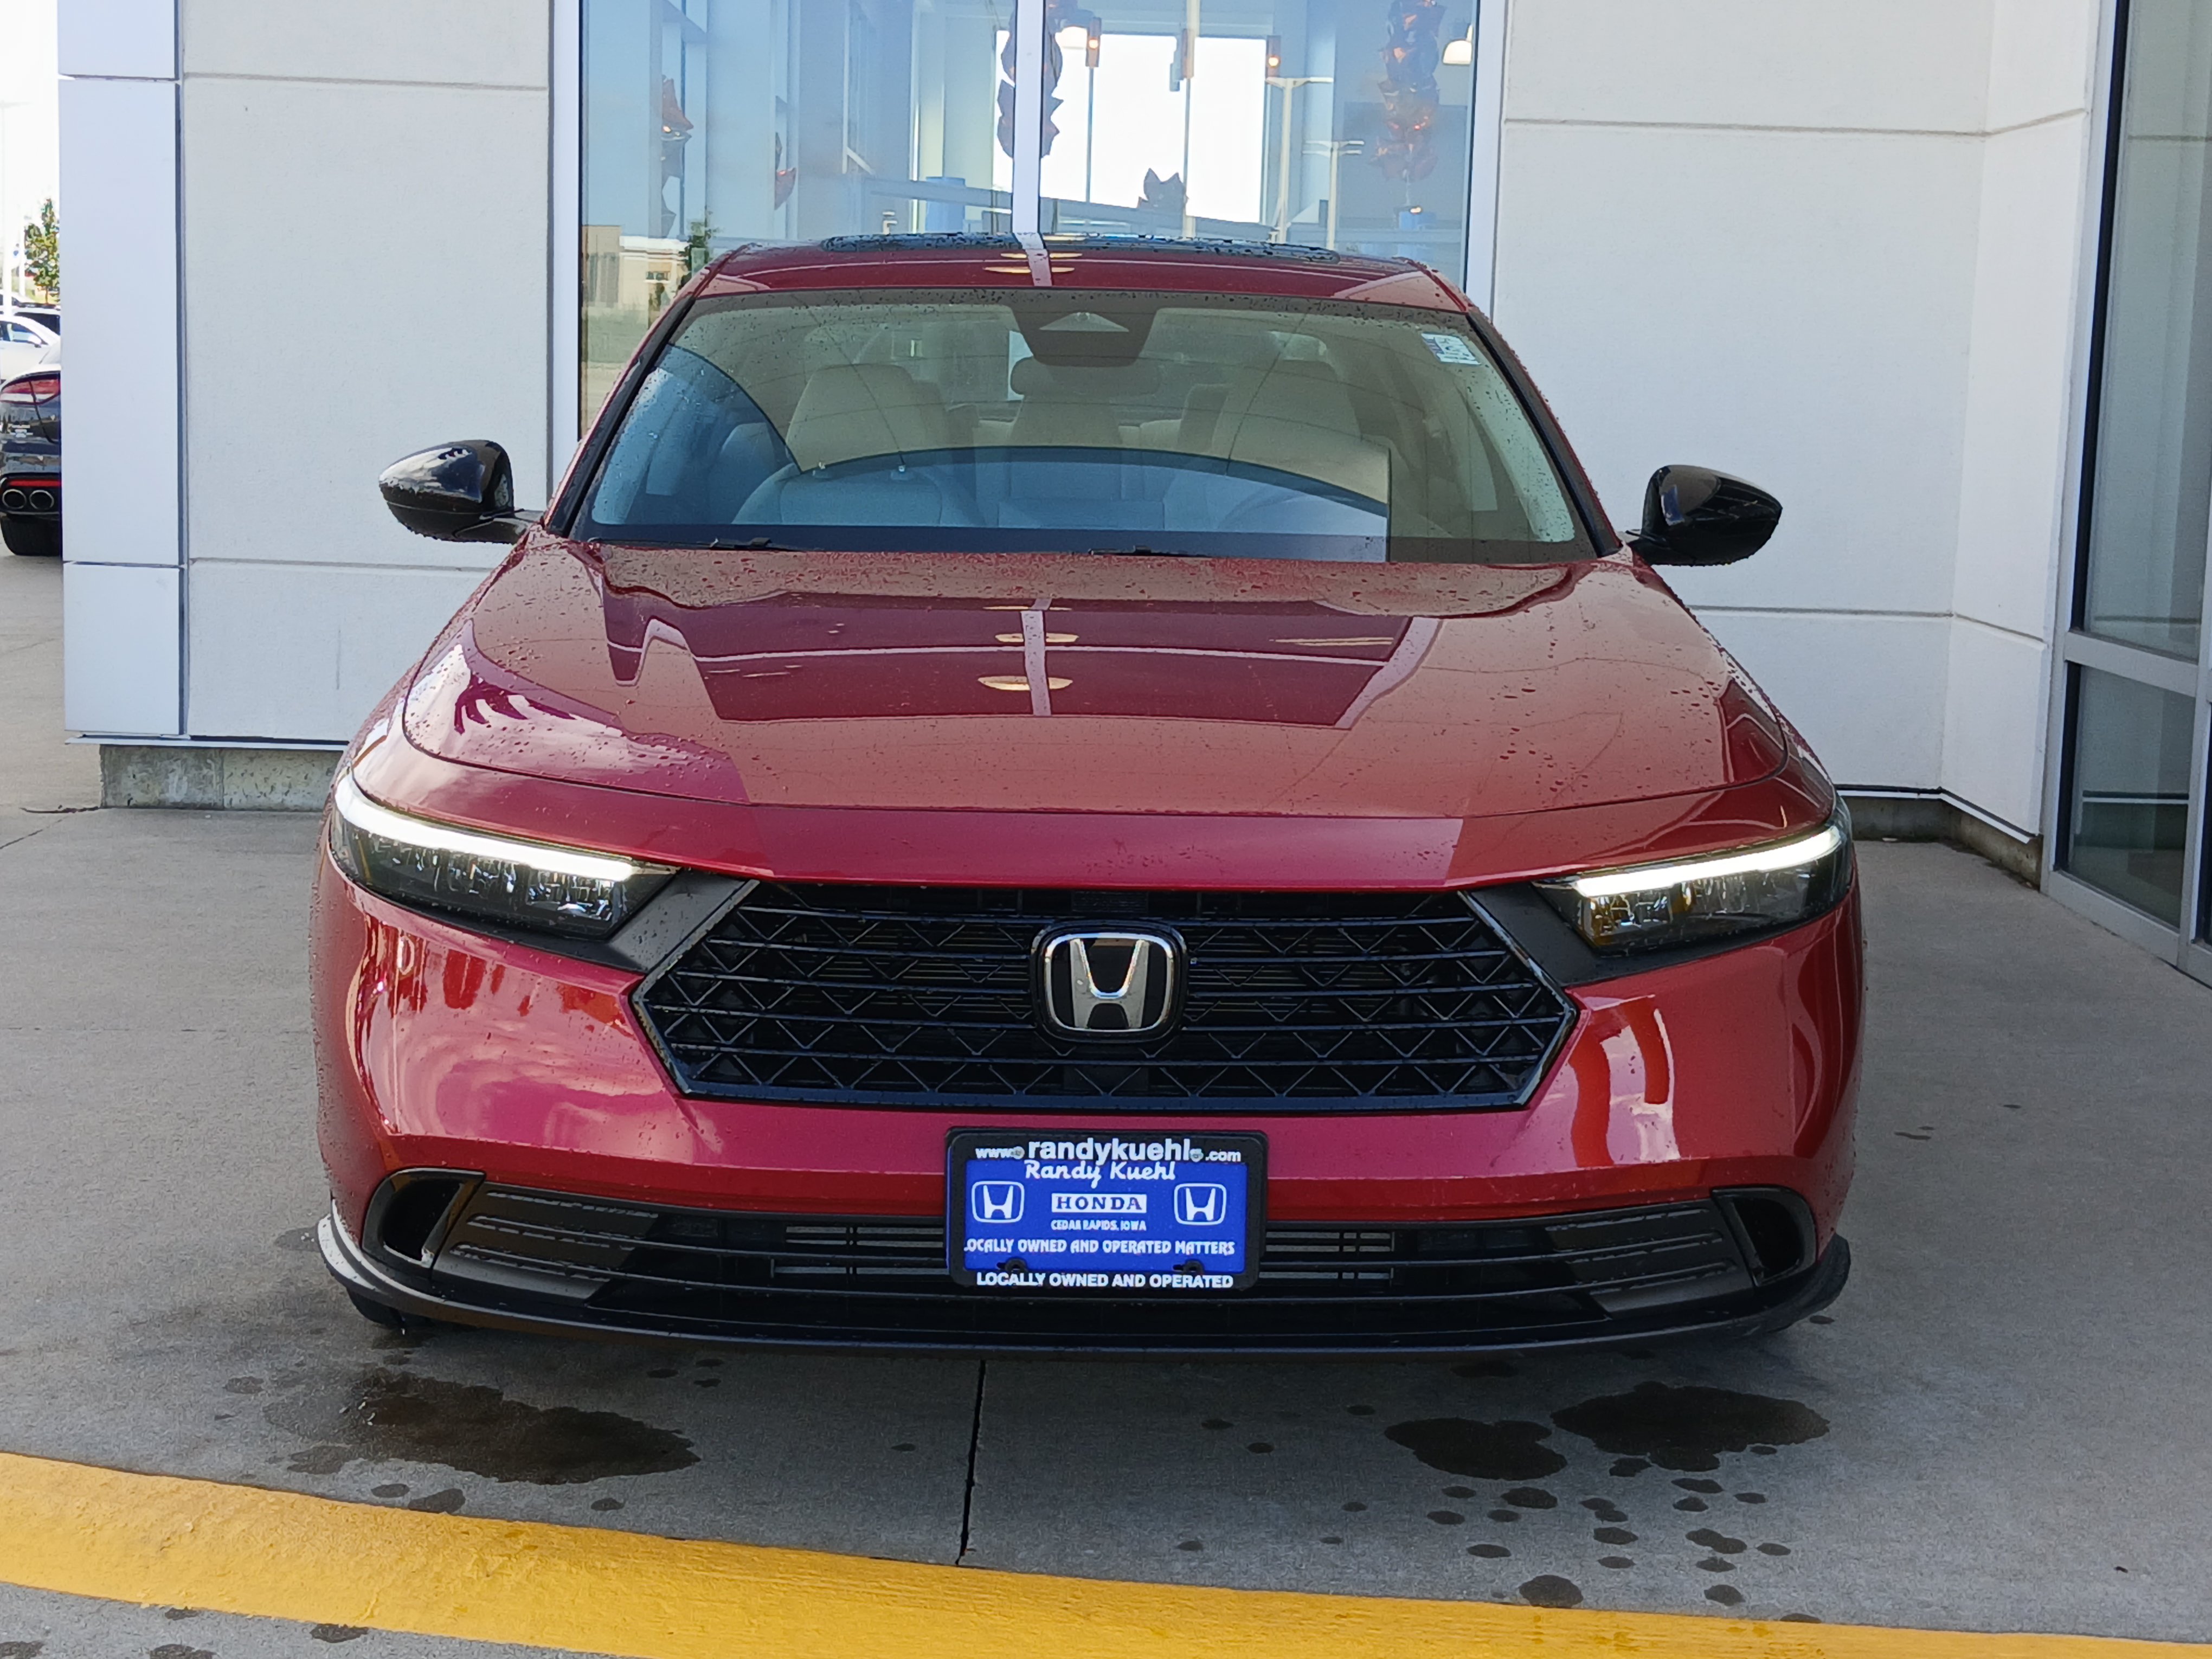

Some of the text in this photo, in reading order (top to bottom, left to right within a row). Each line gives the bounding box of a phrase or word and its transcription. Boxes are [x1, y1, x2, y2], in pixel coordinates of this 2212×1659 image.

[1028, 1137, 1191, 1166] randykuehl
[1205, 1150, 1242, 1162] .com
[1024, 1160, 1176, 1189] Randy Kuehl
[1056, 1196, 1143, 1211] HONDA
[1051, 1219, 1082, 1231] CEDAR
[1120, 1220, 1147, 1231] IOWA
[1018, 1239, 1068, 1253] OWNED
[1070, 1239, 1099, 1254] AND
[1102, 1240, 1172, 1255] OPERATED
[1175, 1240, 1235, 1256] MATTERS
[976, 1271, 1234, 1289] LOCALLY OWNED AND OPERATED
